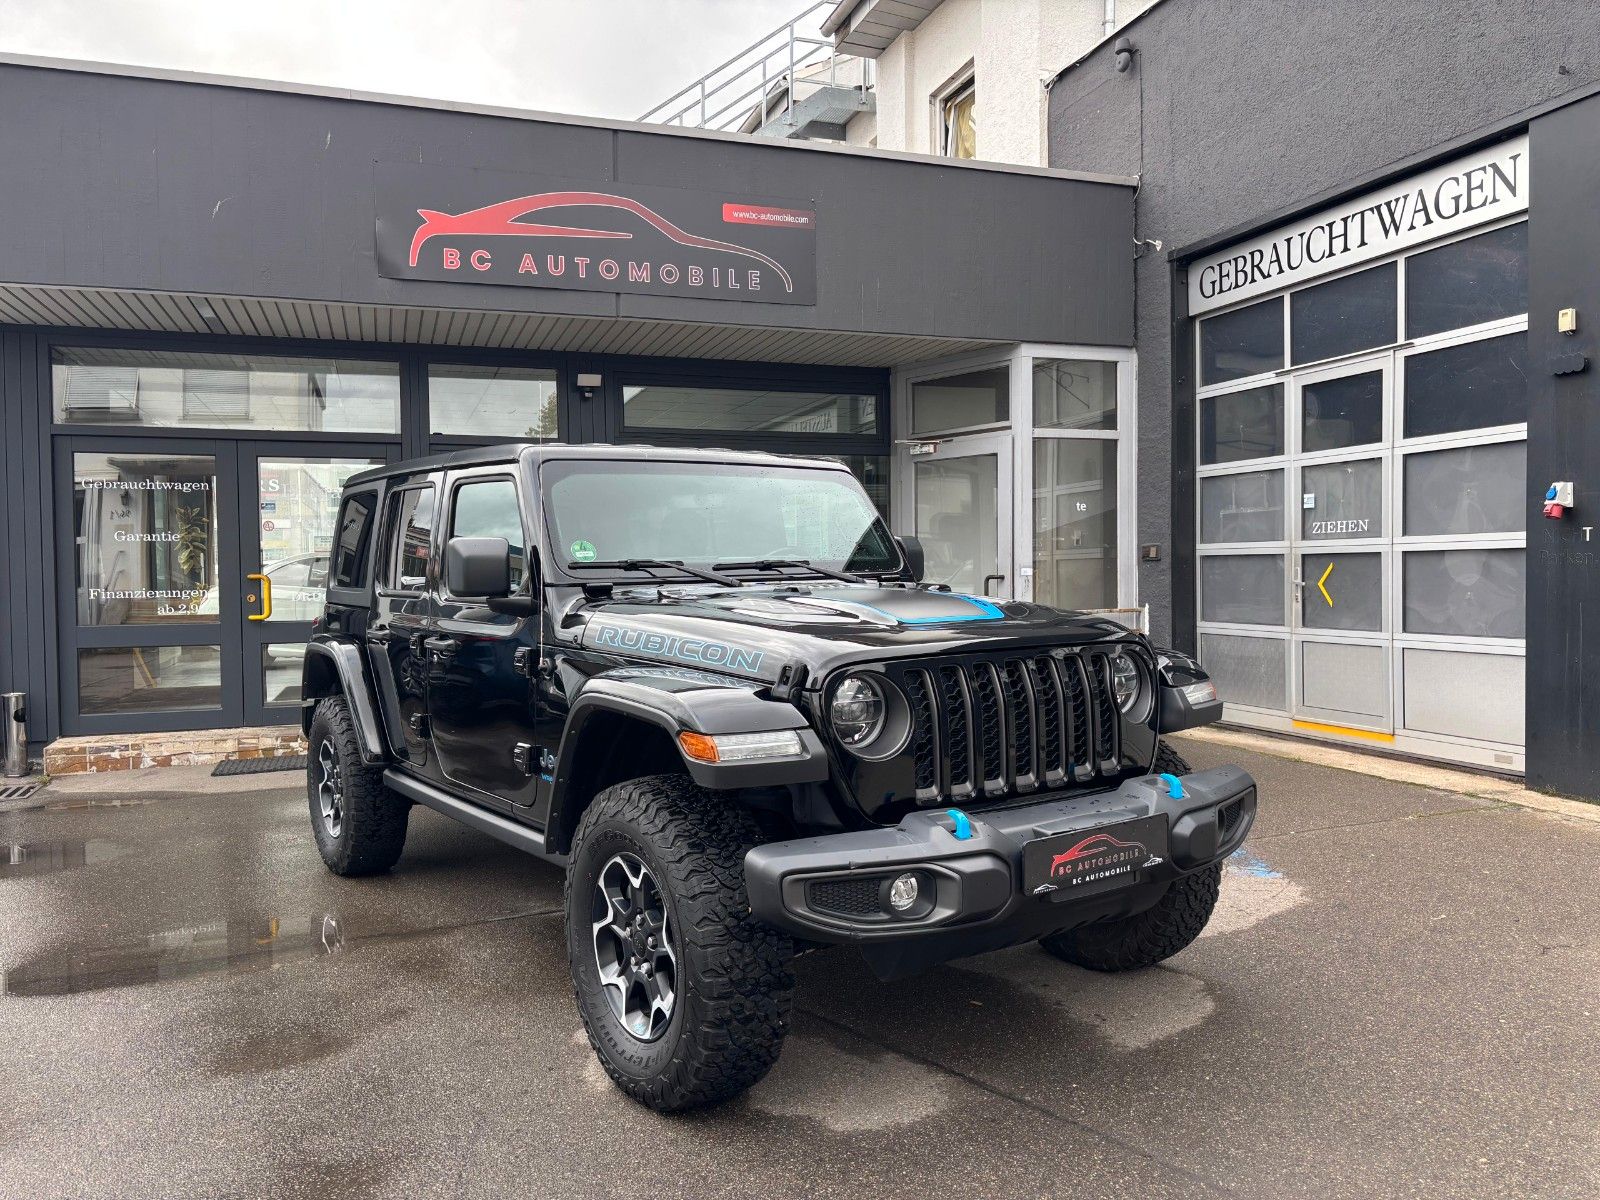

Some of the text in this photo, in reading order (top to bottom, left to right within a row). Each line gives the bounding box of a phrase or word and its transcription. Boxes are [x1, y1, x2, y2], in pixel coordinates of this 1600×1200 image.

[732, 211, 809, 224] www.bc-automobile.com
[1199, 153, 1522, 299] GEBRAUCHTWAGEN
[443, 247, 762, 290] BC AUTOMOBILE
[81, 478, 210, 493] Gebrauchtwagen
[1076, 501, 1087, 511] te
[1311, 518, 1369, 534] ZIEHEN
[114, 530, 181, 542] Garantie
[88, 588, 209, 600] Finanzierungen
[157, 604, 175, 615] ab
[595, 625, 765, 673] RUBICON
[540, 748, 557, 769] Je
[1058, 865, 1072, 876] BC
[1077, 849, 1140, 872] AUTOMOBILE
[1072, 864, 1131, 885] BC AUTOMOBILE
